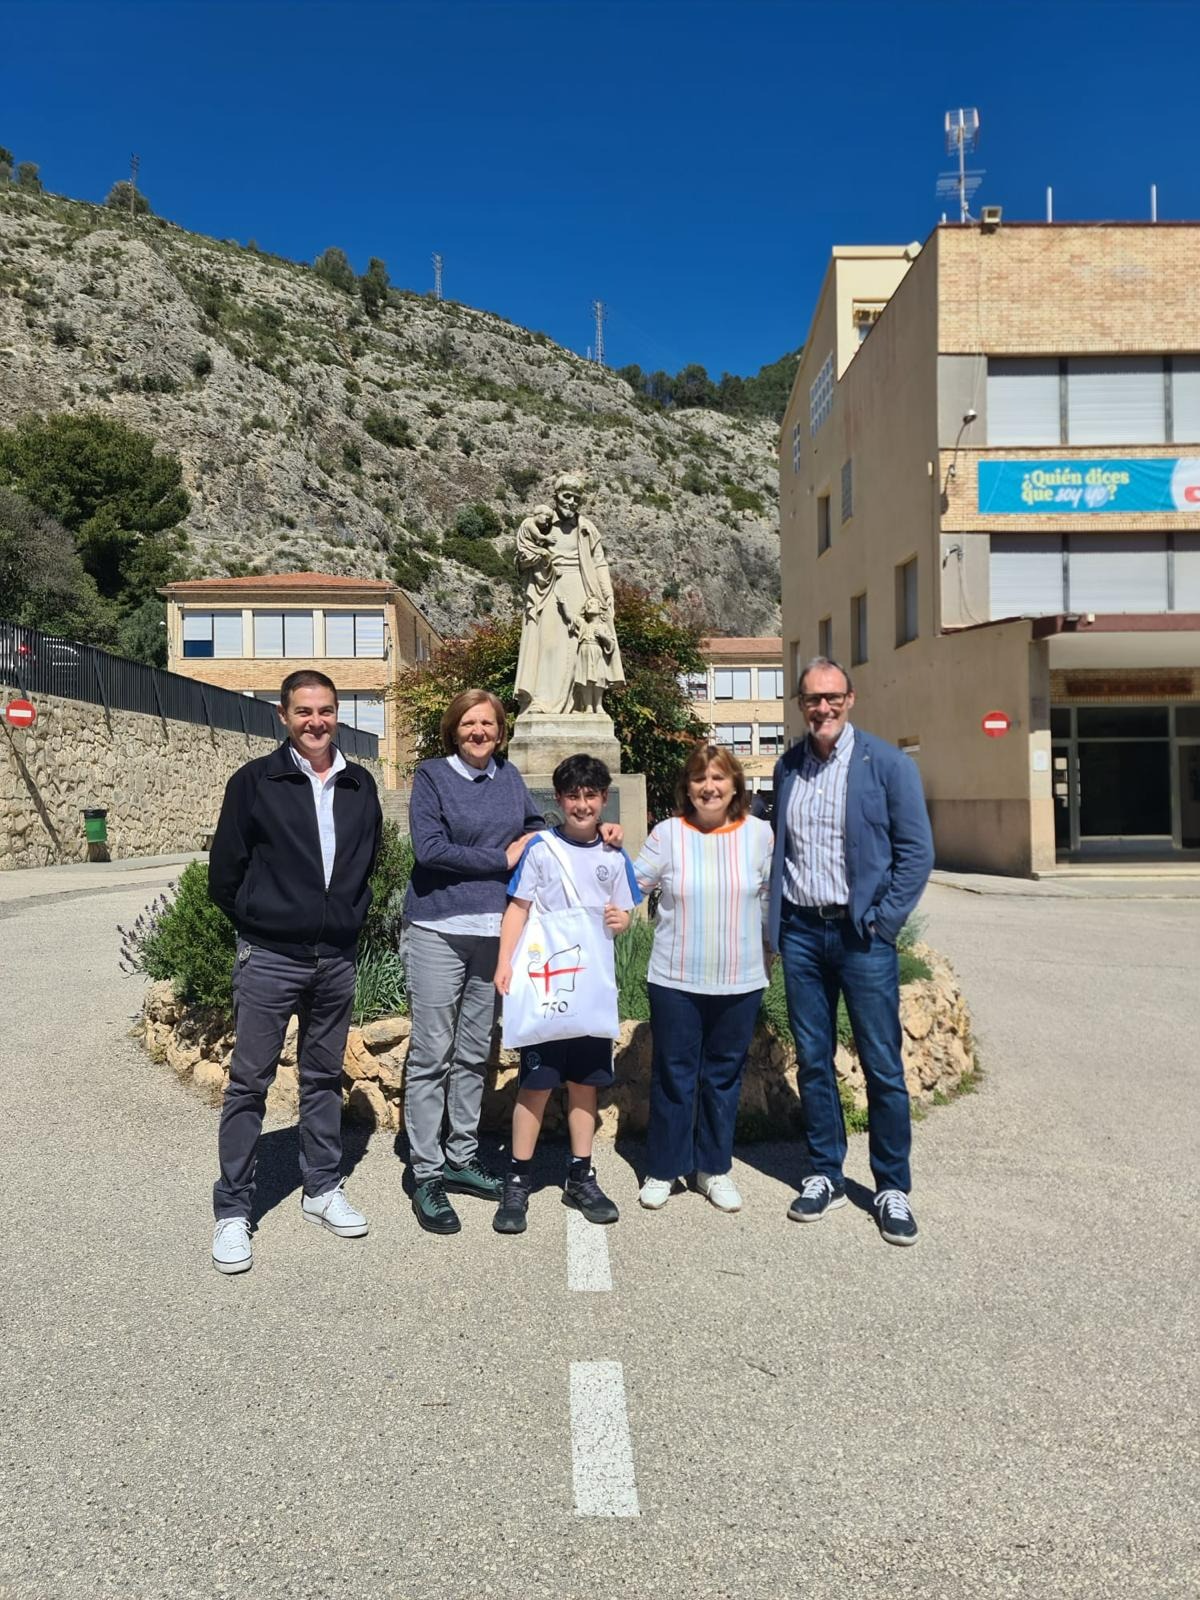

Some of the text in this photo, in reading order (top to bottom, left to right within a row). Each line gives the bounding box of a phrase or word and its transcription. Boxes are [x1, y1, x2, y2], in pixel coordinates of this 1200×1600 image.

[1022, 468, 1130, 490] ¿Quién dices
[1021, 485, 1118, 508] que soy yo?
[541, 1001, 568, 1020] 750
